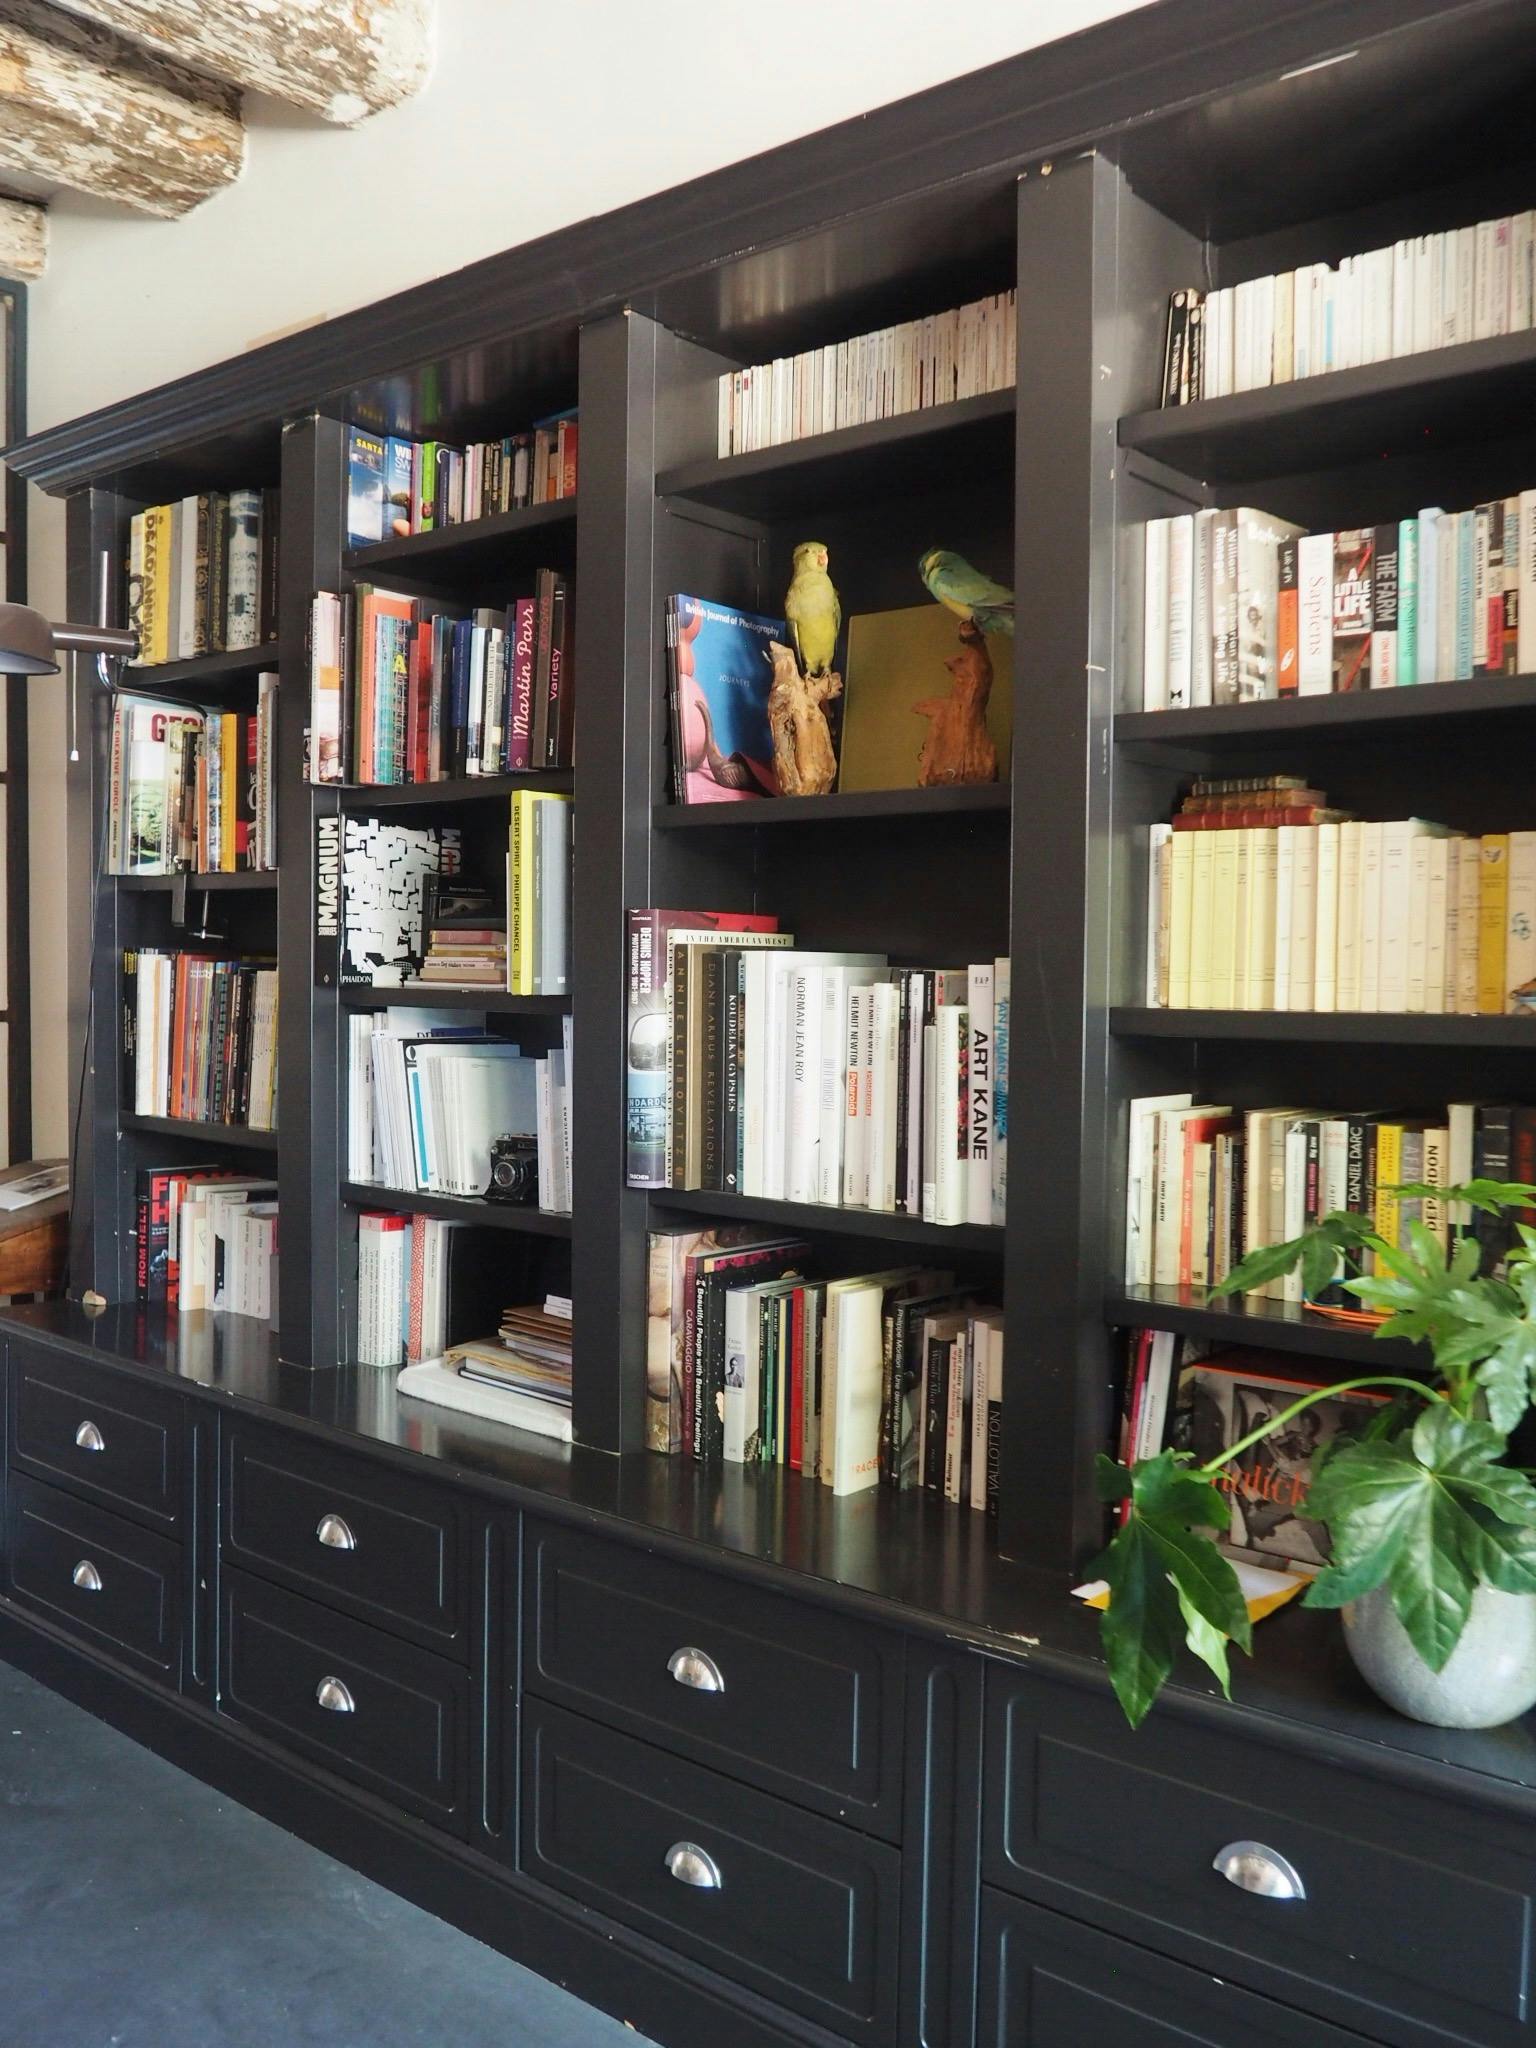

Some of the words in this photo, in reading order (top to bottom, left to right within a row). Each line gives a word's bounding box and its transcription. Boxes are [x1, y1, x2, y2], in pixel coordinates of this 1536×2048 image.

[1228, 529, 1237, 578] William
[1376, 551, 1397, 580] THE
[1335, 580, 1371, 596] LITTLE
[1348, 568, 1358, 581] A
[142, 574, 156, 655] ANNUAL
[685, 603, 707, 617] British
[707, 609, 730, 625] Journal
[730, 616, 738, 625] of
[738, 618, 780, 638] Photography
[1304, 576, 1326, 656] Sapiens
[1335, 595, 1370, 616] LIFE
[1376, 582, 1397, 622] FARM
[518, 604, 534, 656] Parr
[550, 648, 562, 701] Variety
[719, 674, 750, 688] JOURNEYS
[513, 661, 530, 737] Martin
[318, 817, 339, 926] MAGNUM
[640, 927, 651, 960] DENNIS
[686, 935, 695, 943] IN
[697, 935, 714, 944] THE
[716, 936, 763, 945] AMERICAN
[765, 937, 788, 945] WEST
[342, 975, 372, 984] PHAIDON
[640, 962, 652, 994] HOPPER
[676, 951, 685, 1021] ANNIE
[708, 963, 716, 1006] DIANE
[796, 977, 806, 1026] NORMAN
[851, 996, 859, 1030] HELMUT
[707, 1014, 715, 1060] ARBUS
[728, 994, 736, 1061] KOUDELKA
[795, 1029, 805, 1057] JEAN
[850, 1031, 858, 1066] NEWTON
[973, 1029, 988, 1081] ART
[727, 1063, 735, 1113] GYPSIES
[793, 1061, 804, 1082] ROY
[675, 1035, 684, 1156] LEIBOVITZ
[705, 1071, 715, 1172] REVELATIONS
[973, 1089, 988, 1160] KANE
[1350, 1127, 1363, 1159] DARC
[629, 1173, 649, 1181] TASCHEN
[1349, 1168, 1361, 1203] DANIEL
[138, 1205, 148, 1246] HELL
[138, 1248, 147, 1288] FROM
[697, 1288, 705, 1326] Beautiful
[695, 1358, 703, 1377] with
[694, 1378, 702, 1415] Beautiful
[693, 1417, 701, 1453] Feelings
